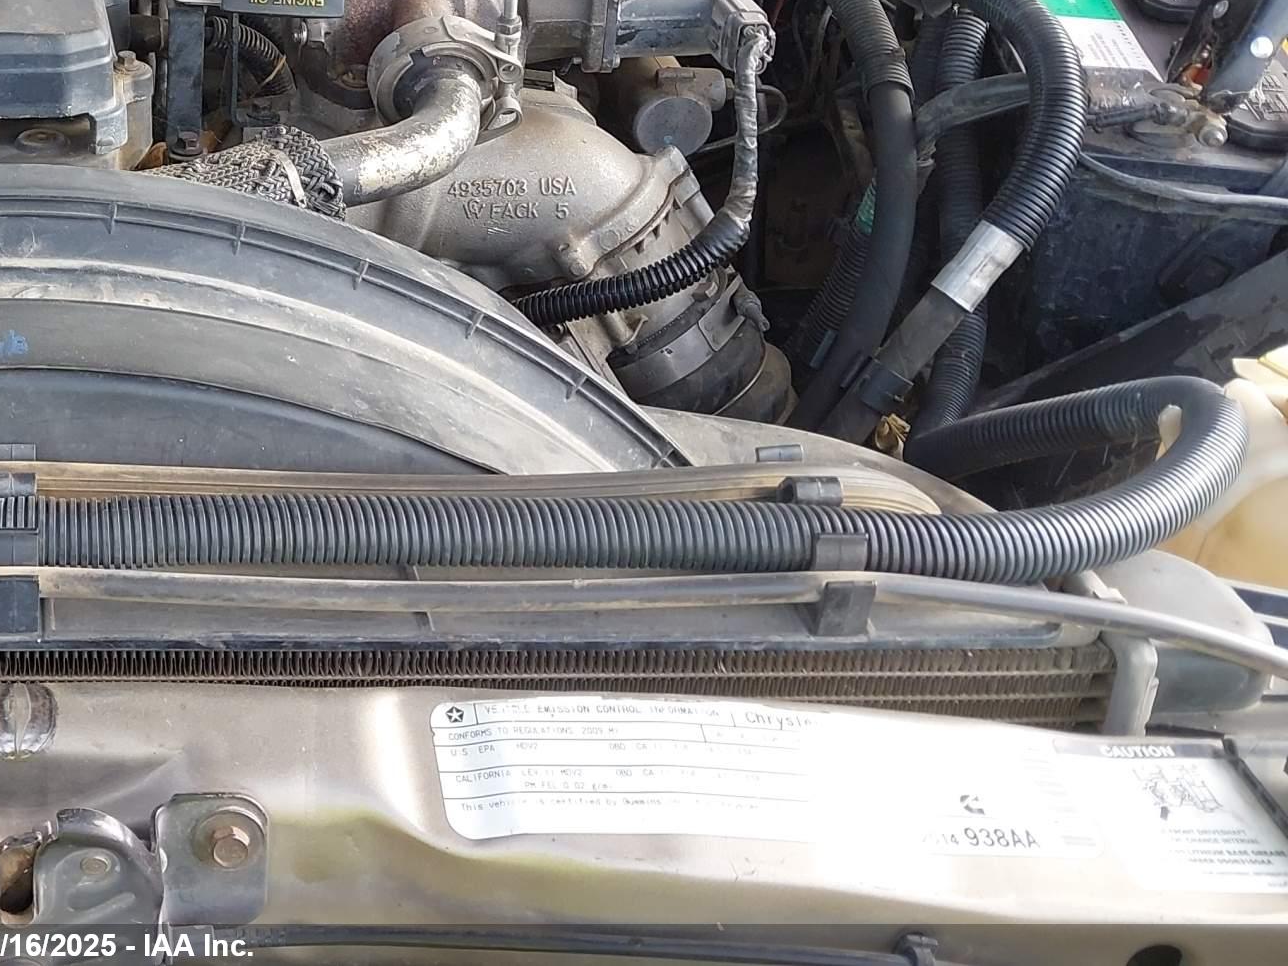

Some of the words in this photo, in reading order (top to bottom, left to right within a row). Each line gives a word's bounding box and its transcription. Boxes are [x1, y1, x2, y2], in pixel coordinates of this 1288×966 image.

[447, 177, 528, 198] 4935703
[540, 176, 578, 196] USA
[555, 202, 570, 220] 5
[596, 704, 641, 714] CONTROL
[448, 729, 492, 740] CONFORMS
[498, 726, 508, 734] TO
[478, 744, 496, 753] EPA
[1099, 744, 1176, 758] CAUTION
[456, 769, 512, 783] CALIFORNIA
[964, 826, 1040, 848] 938AA
